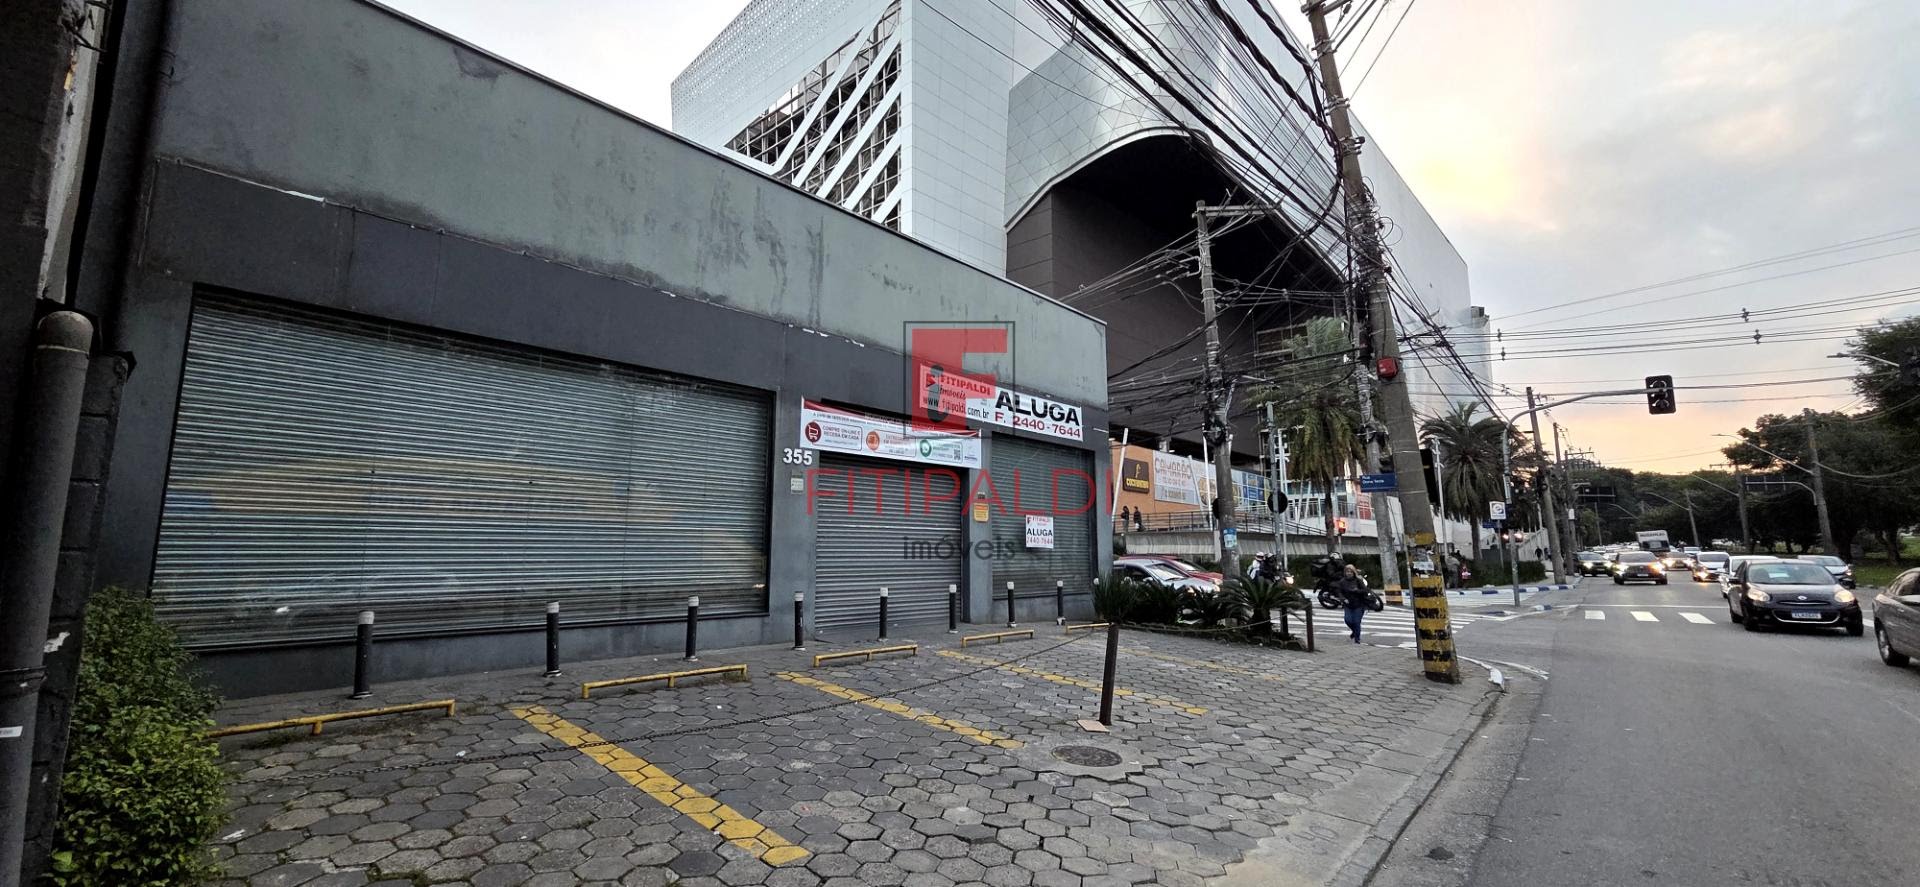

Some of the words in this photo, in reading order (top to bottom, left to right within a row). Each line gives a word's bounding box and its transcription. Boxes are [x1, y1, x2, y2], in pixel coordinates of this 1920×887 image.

[940, 374, 990, 396] FITIPALDI
[995, 390, 1080, 426] ALUGA
[783, 448, 813, 466] 355
[1027, 528, 1053, 537] ALUGA
